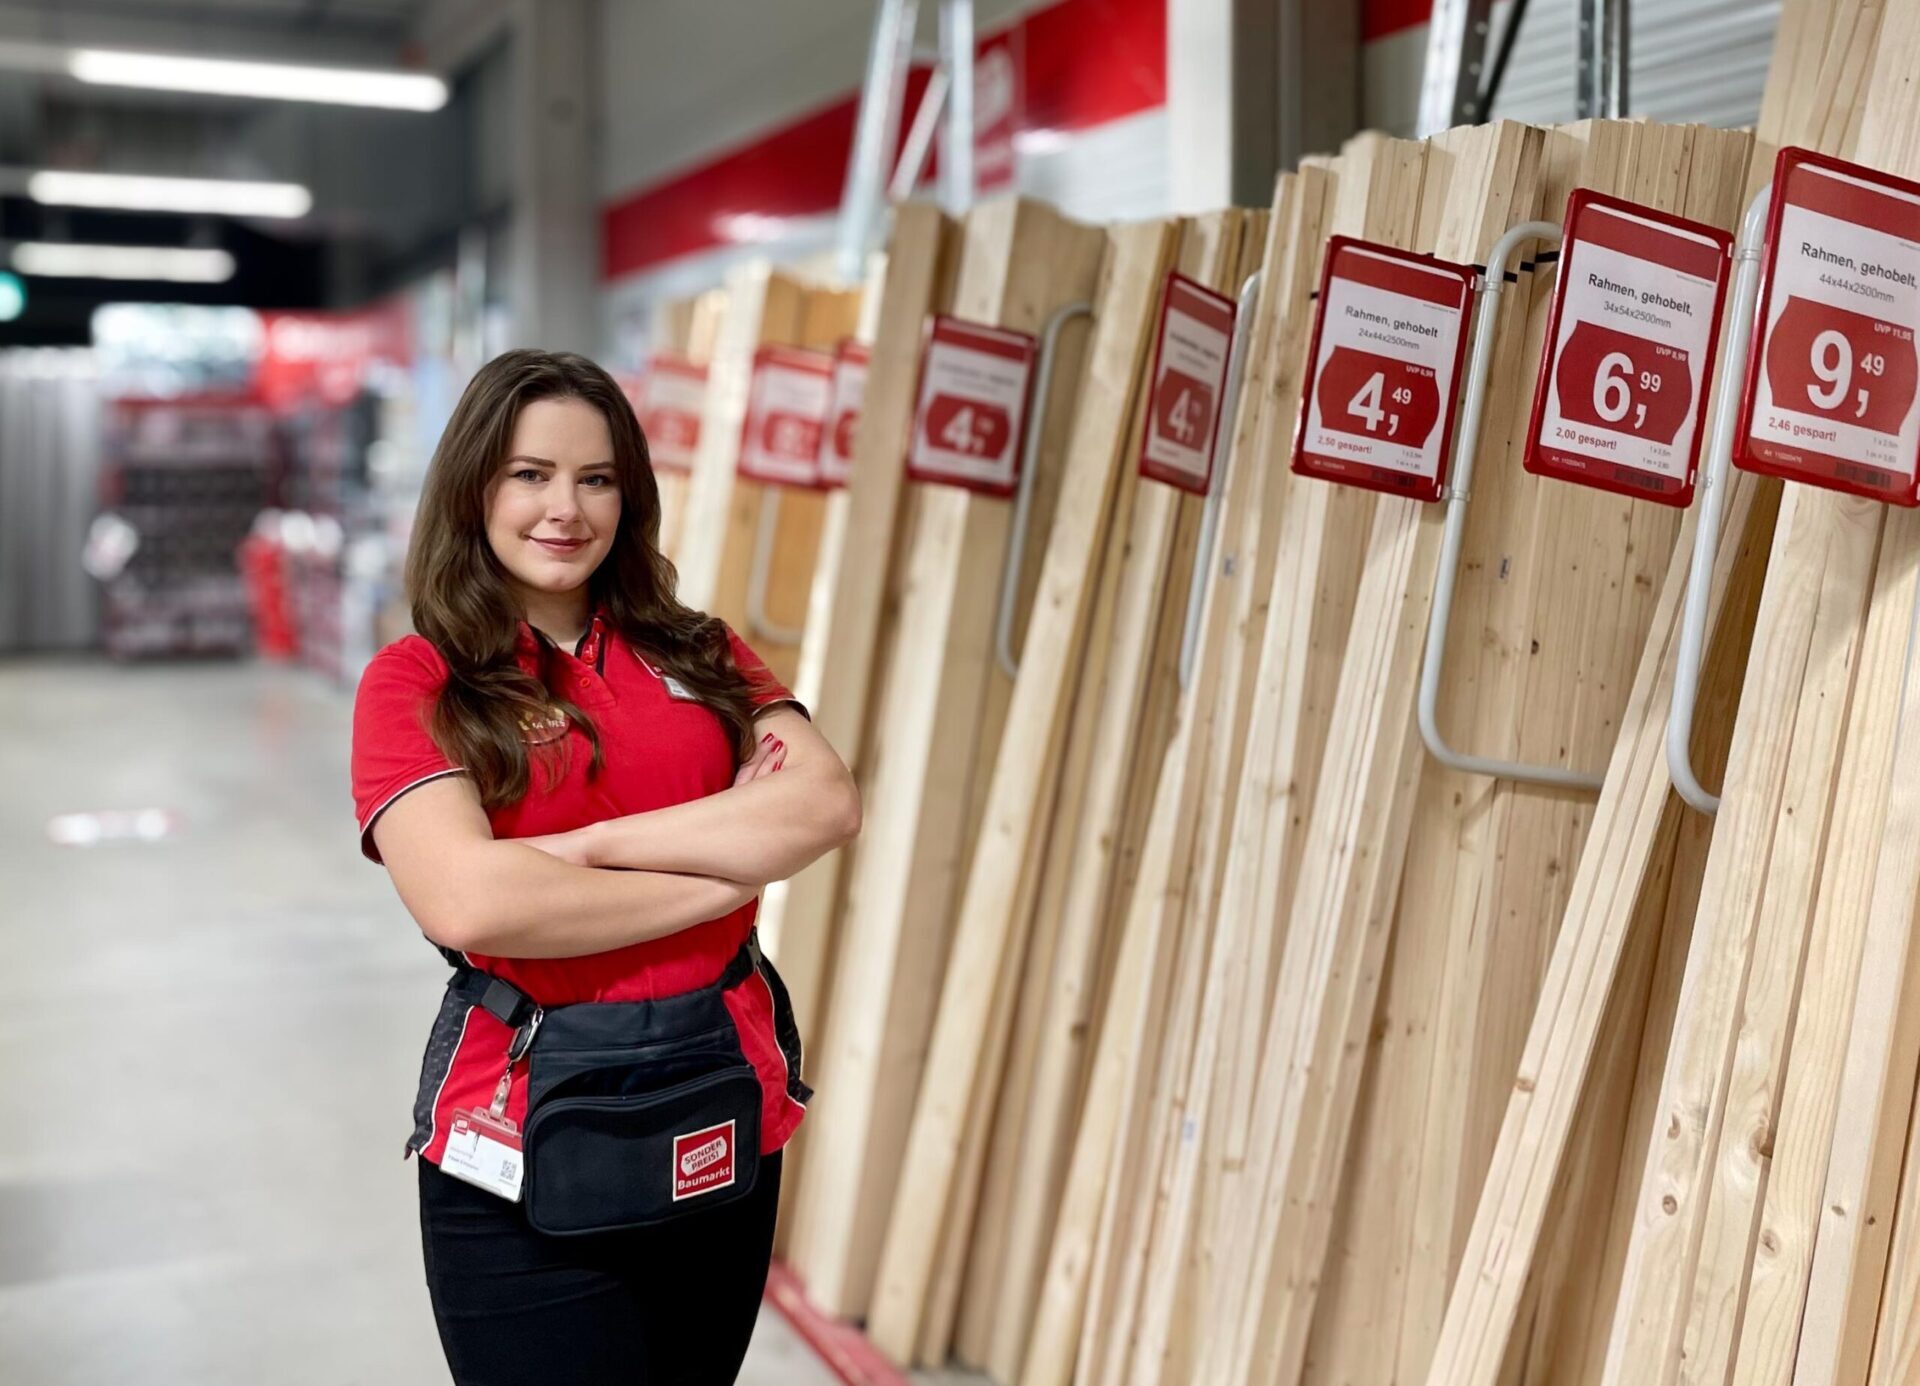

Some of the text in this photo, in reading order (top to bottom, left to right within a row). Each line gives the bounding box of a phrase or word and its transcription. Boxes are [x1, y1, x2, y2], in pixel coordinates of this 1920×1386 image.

[1801, 242, 1917, 290] Rahmen, gehobelt,
[1588, 273, 1692, 317] Rahmen, gehobelt,
[1819, 273, 1895, 303] 44x44x2500mm
[1345, 305, 1439, 338] Rahmen, gehobelt
[1603, 300, 1672, 328] 34x54x2500mm
[1358, 327, 1420, 350] 24x44x2500mm
[1874, 323, 1891, 334] UVP
[1656, 346, 1671, 356] UVP
[1555, 427, 1617, 450] 2,00 gespart!
[1768, 417, 1837, 442] 2,46 gespart!
[1317, 435, 1373, 454] 2,50 gespart!
[684, 1140, 722, 1165] SONDER
[691, 1151, 719, 1171] PREIS!
[677, 1166, 730, 1190] Baumarkt
